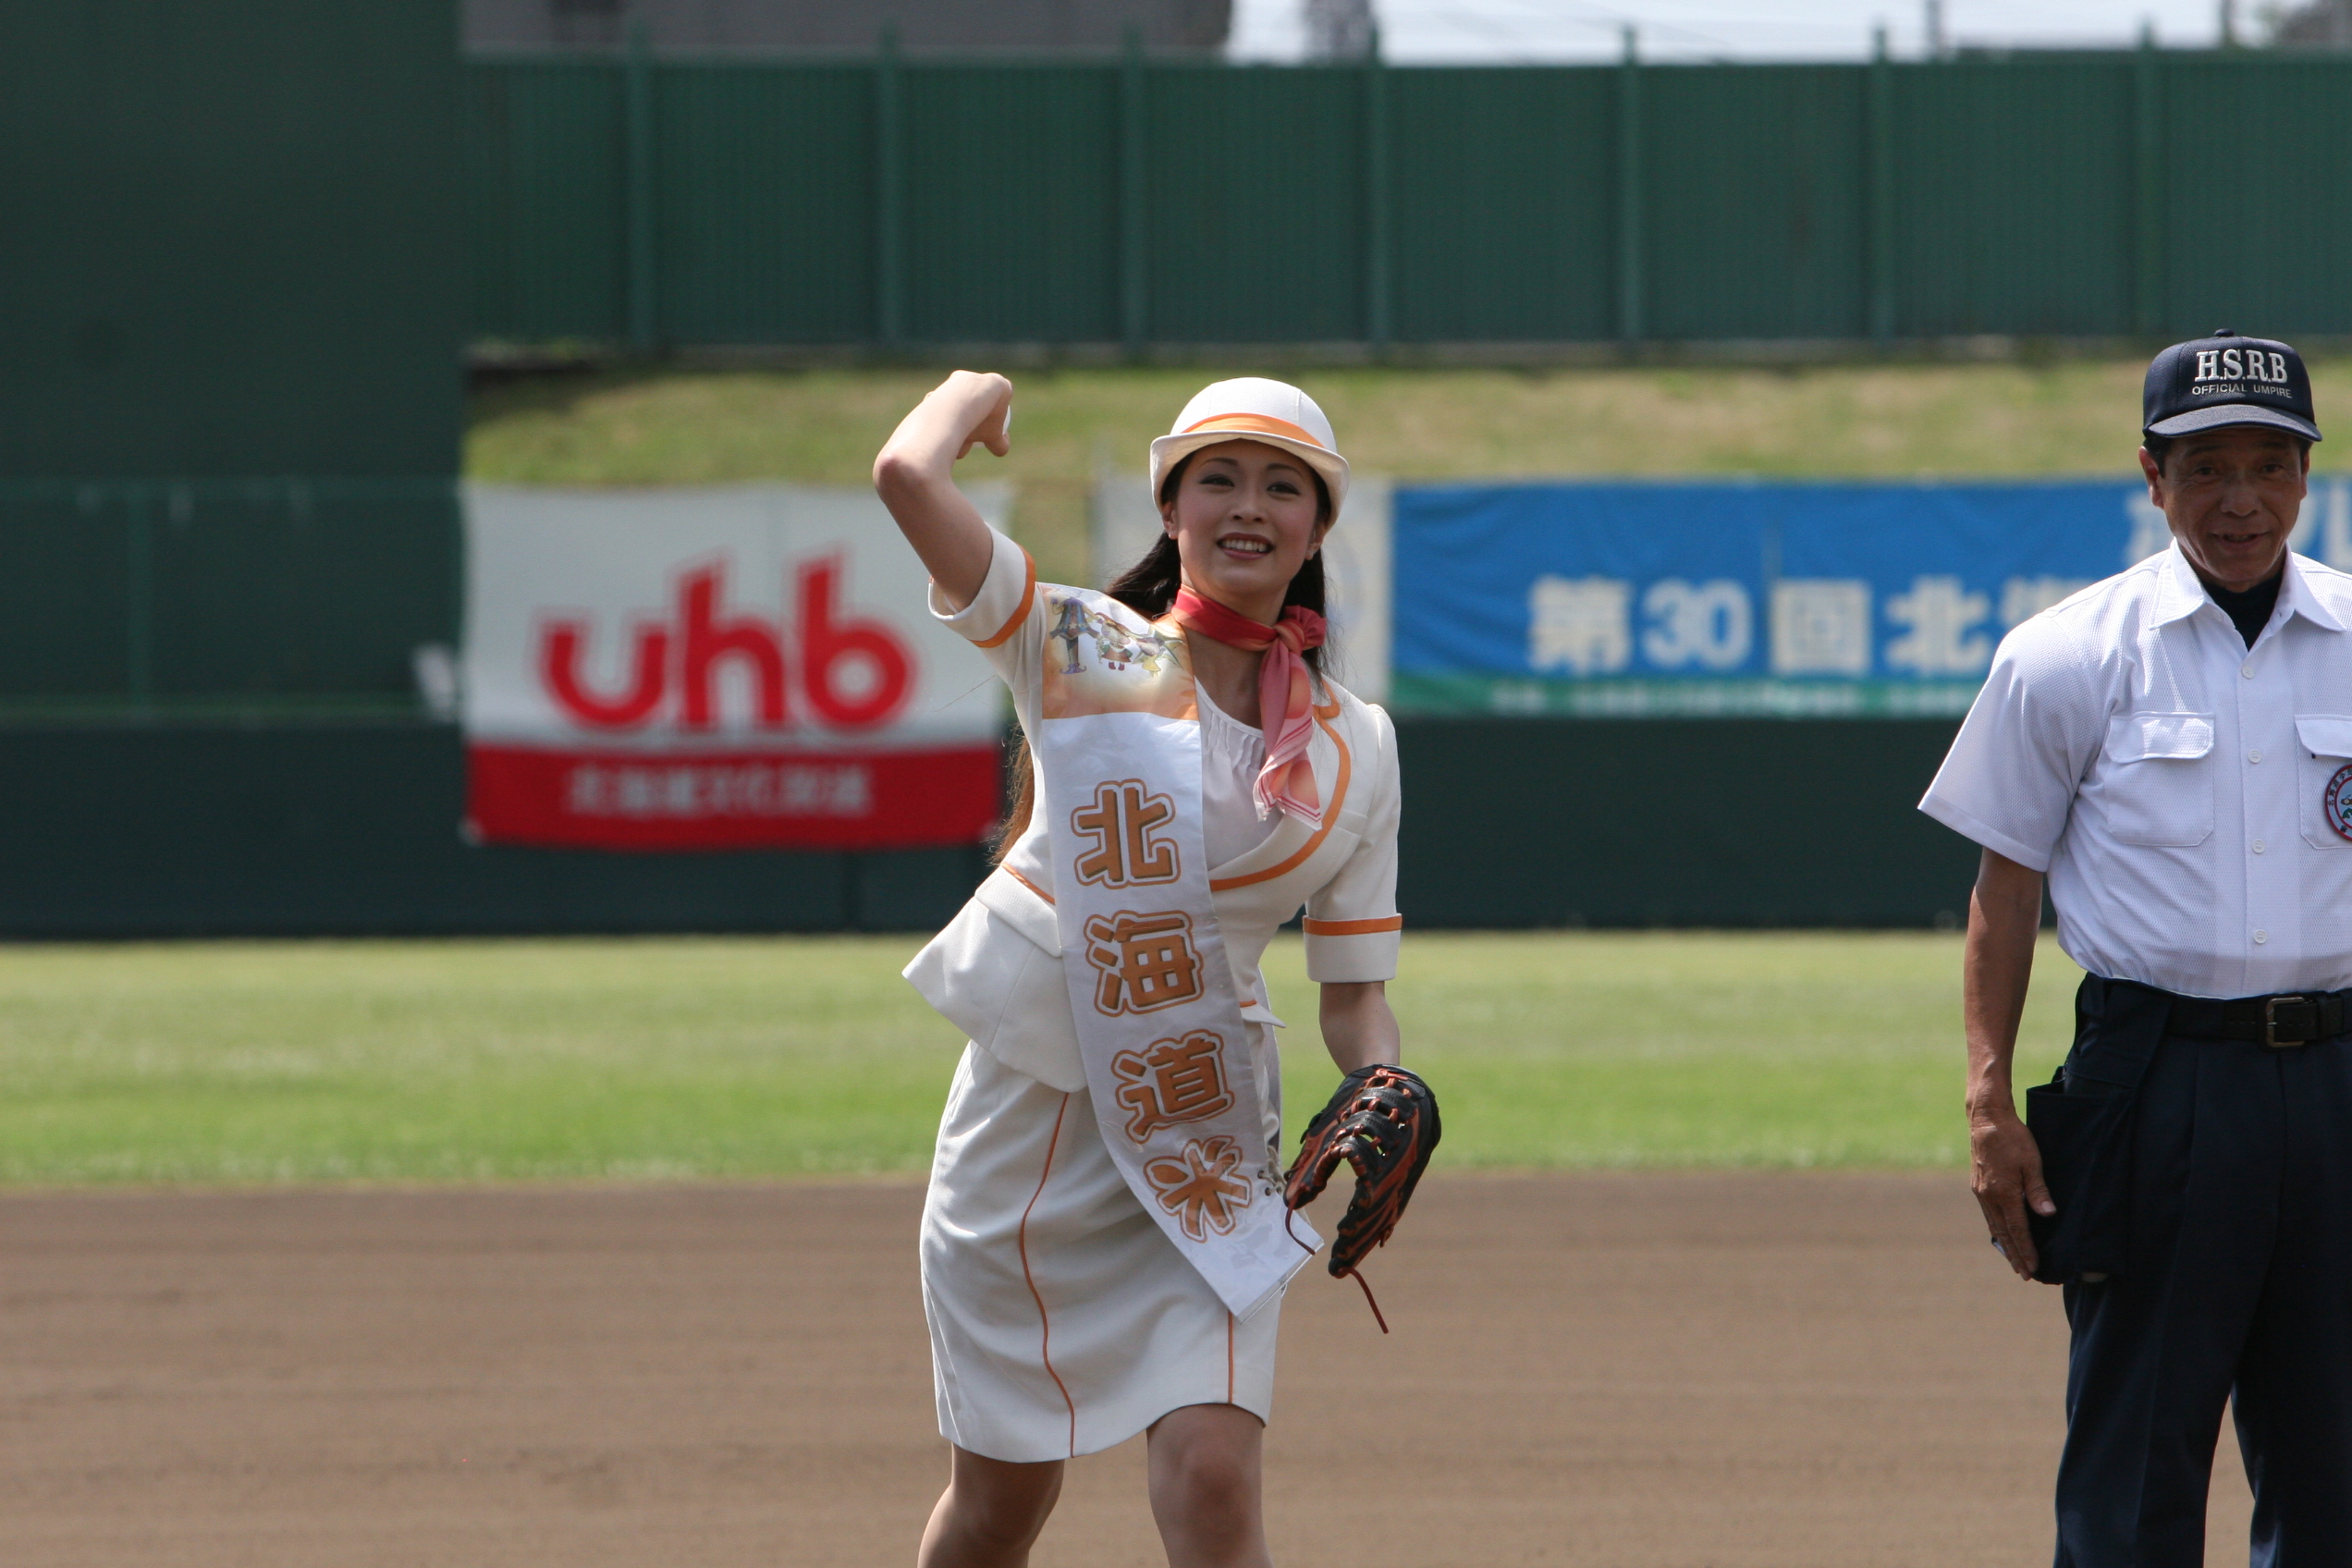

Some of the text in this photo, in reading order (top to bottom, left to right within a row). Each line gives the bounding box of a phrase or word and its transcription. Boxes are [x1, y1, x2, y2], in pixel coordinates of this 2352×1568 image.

[2191, 383, 2293, 398] OFFICIAL UMPIRE
[540, 557, 915, 730] uhb
[1070, 778, 1253, 1243] 北海道米
